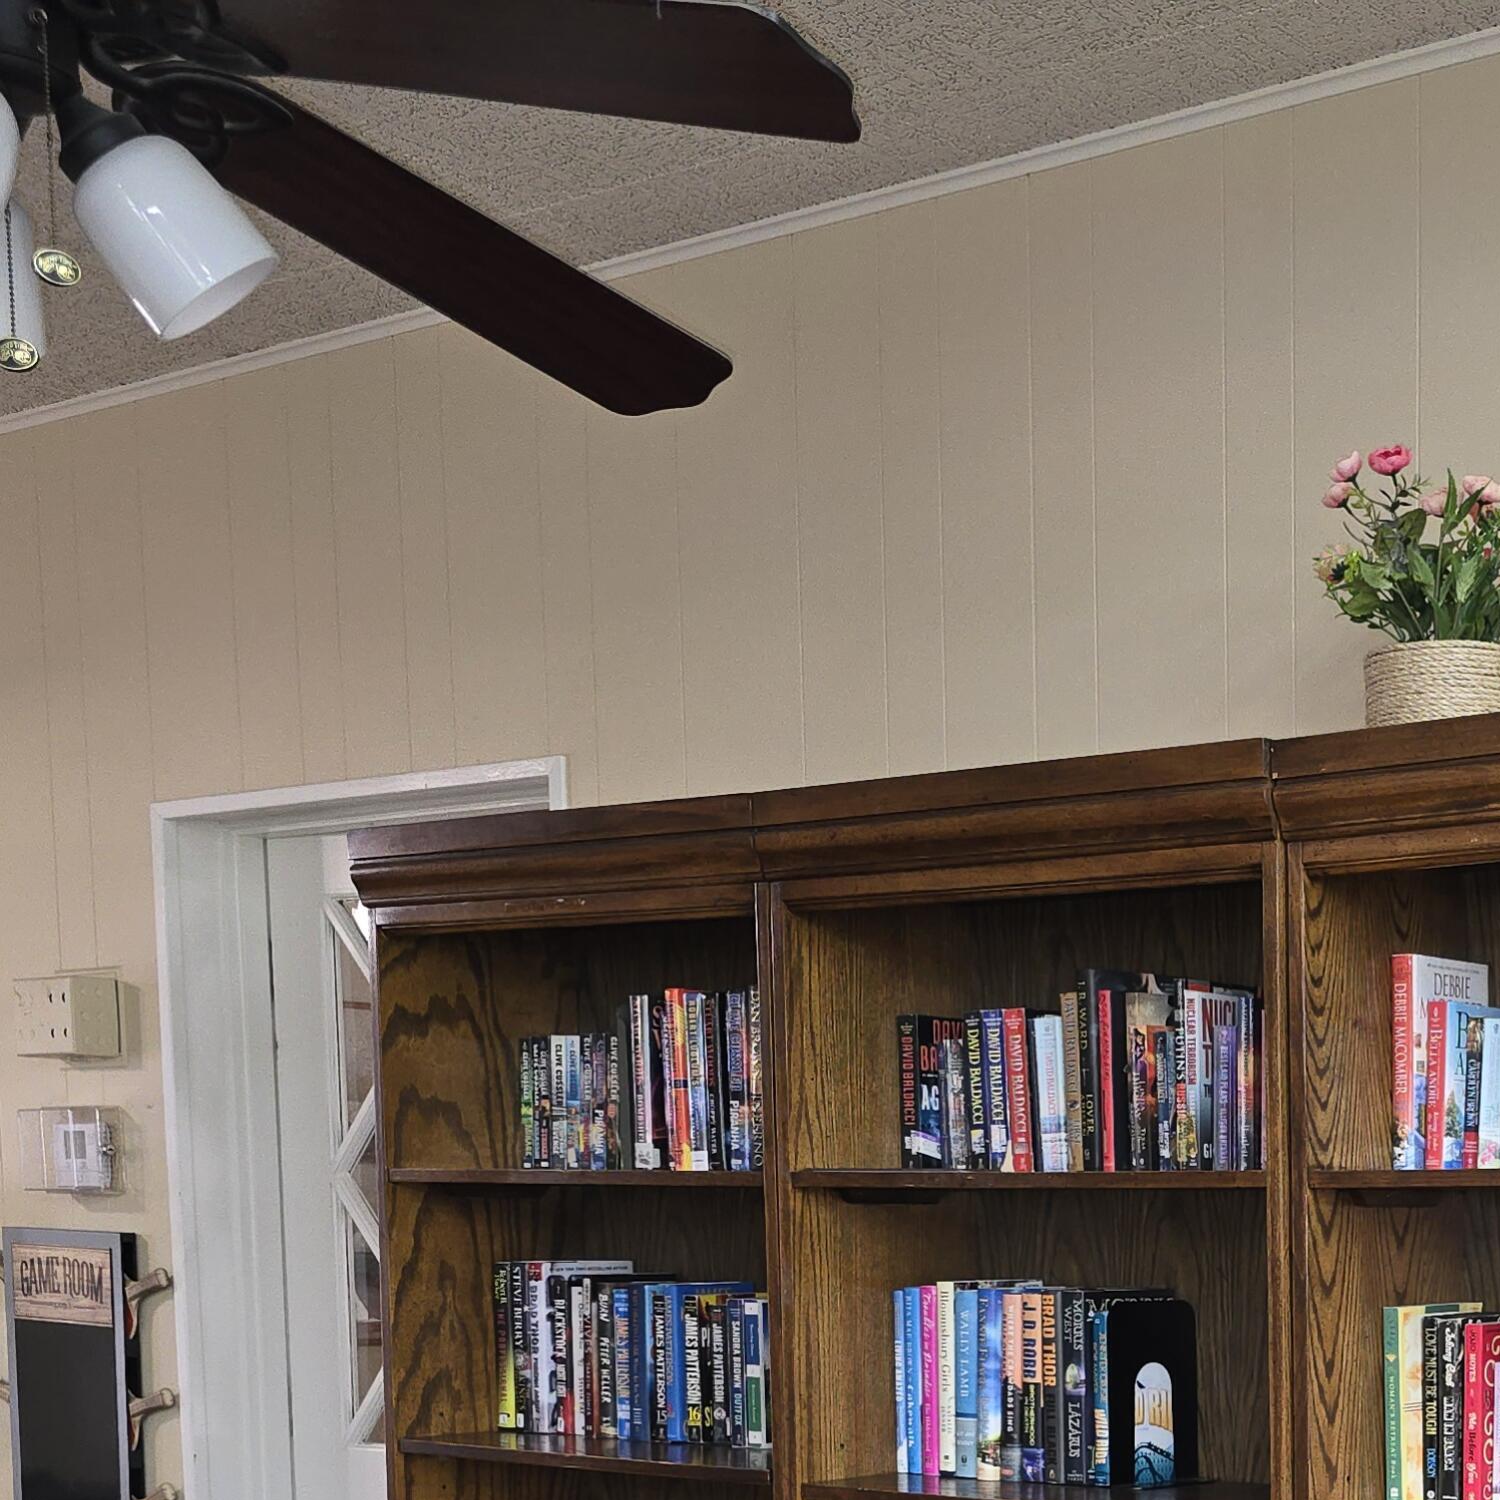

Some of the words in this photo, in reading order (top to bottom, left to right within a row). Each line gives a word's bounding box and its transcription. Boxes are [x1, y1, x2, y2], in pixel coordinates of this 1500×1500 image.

[1188, 998, 1197, 1035] NUCLEAR
[1395, 983, 1405, 1022] DEBBIE
[555, 1044, 563, 1067] CLIVE
[610, 1037, 618, 1059] CLIVE
[903, 1036, 914, 1069] DAVID
[968, 1029, 980, 1064] DAVID
[987, 1029, 1000, 1062] DAVID
[1010, 1034, 1022, 1071] DAVID
[1396, 1027, 1407, 1095] MACOMBER
[610, 1063, 619, 1100] CUSSLER
[904, 1073, 915, 1125] BALDACCI
[970, 1068, 983, 1124] BALDACCI
[990, 1066, 1004, 1120] BALDACCI
[1012, 1075, 1026, 1133] BALDACCI
[730, 1100, 742, 1150] PIRANHA
[20, 1256, 61, 1297] GAME
[62, 1256, 104, 1304] ROOM
[513, 1266, 521, 1305] STEVE
[599, 1294, 609, 1322] BURN
[939, 1291, 950, 1361] Bloomsbury
[1023, 1302, 1036, 1315] J.
[1042, 1295, 1054, 1339] BRAD
[1064, 1307, 1072, 1343] WEST
[1073, 1299, 1083, 1351] MORRIS
[514, 1308, 523, 1348] BERRY
[685, 1314, 698, 1347] JAMES
[713, 1324, 723, 1352] JAMES
[960, 1310, 969, 1354] WALLY
[1023, 1323, 1036, 1334] D.
[1425, 1327, 1436, 1354] LOVE
[601, 1337, 610, 1364] PETER
[1023, 1339, 1036, 1379] ROBB
[1044, 1343, 1056, 1386] THOR
[1469, 1353, 1477, 1382] MOYES
[602, 1369, 611, 1403] HELLER
[657, 1349, 665, 1408] PATTERSON
[686, 1350, 700, 1404] PATTERSON
[714, 1354, 724, 1402] PATTERSON
[941, 1364, 951, 1392] Girls
[961, 1360, 969, 1397] LAMB
[1426, 1356, 1436, 1384] MUST
[1426, 1385, 1436, 1399] BE
[1094, 1409, 1108, 1437] WILD
[1426, 1401, 1437, 1435] TOUGH
[1095, 1439, 1108, 1465] RIDE
[1468, 1432, 1476, 1461] Before
